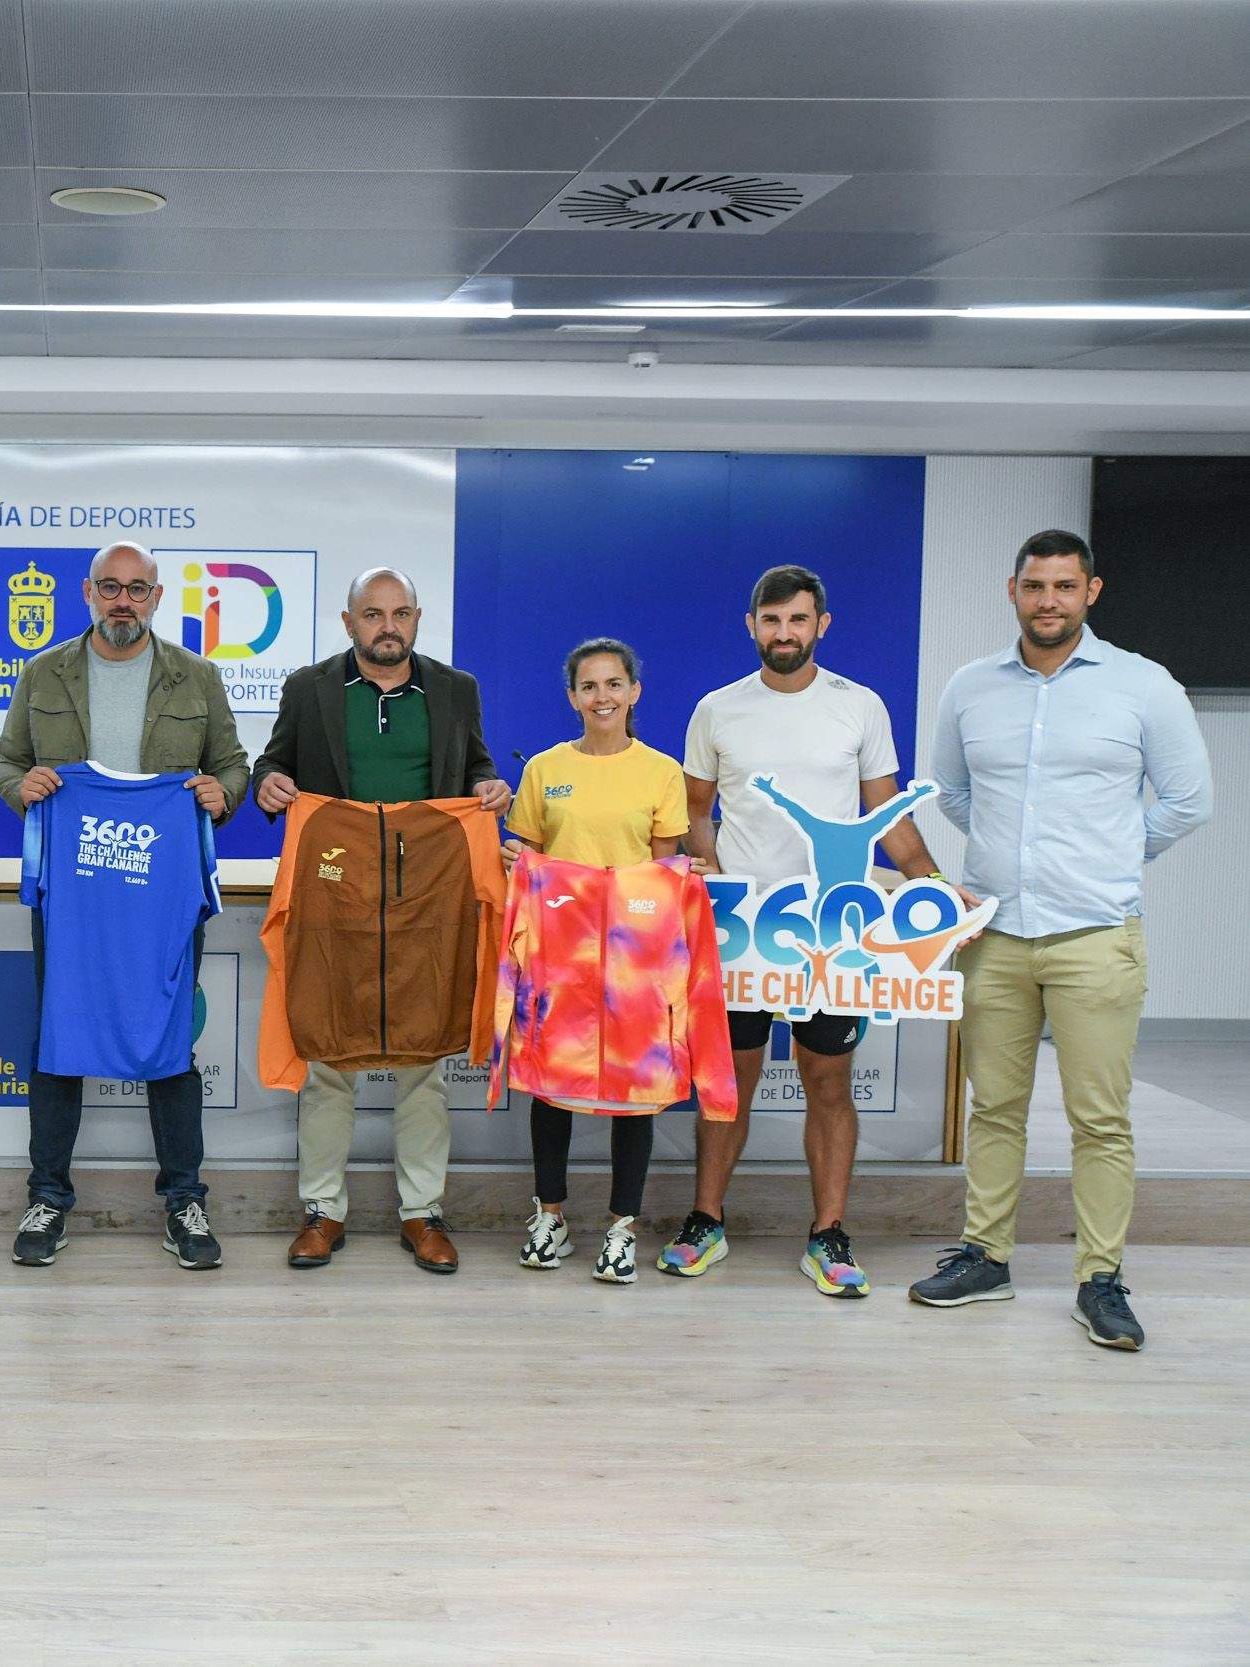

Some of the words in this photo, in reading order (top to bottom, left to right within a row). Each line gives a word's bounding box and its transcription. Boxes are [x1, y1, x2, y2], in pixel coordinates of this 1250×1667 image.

[30, 506, 62, 527] DE
[70, 506, 196, 529] DEPORTES
[77, 852, 105, 868] GRAN
[106, 857, 149, 874] CANARIA
[79, 842, 97, 855] THE
[97, 845, 152, 863] CHALLENGE
[722, 971, 754, 1003] HE
[761, 972, 955, 1012] CHALLENGE
[367, 1072, 385, 1082] Isla
[99, 1084, 116, 1095] DE
[761, 1088, 778, 1100] DE
